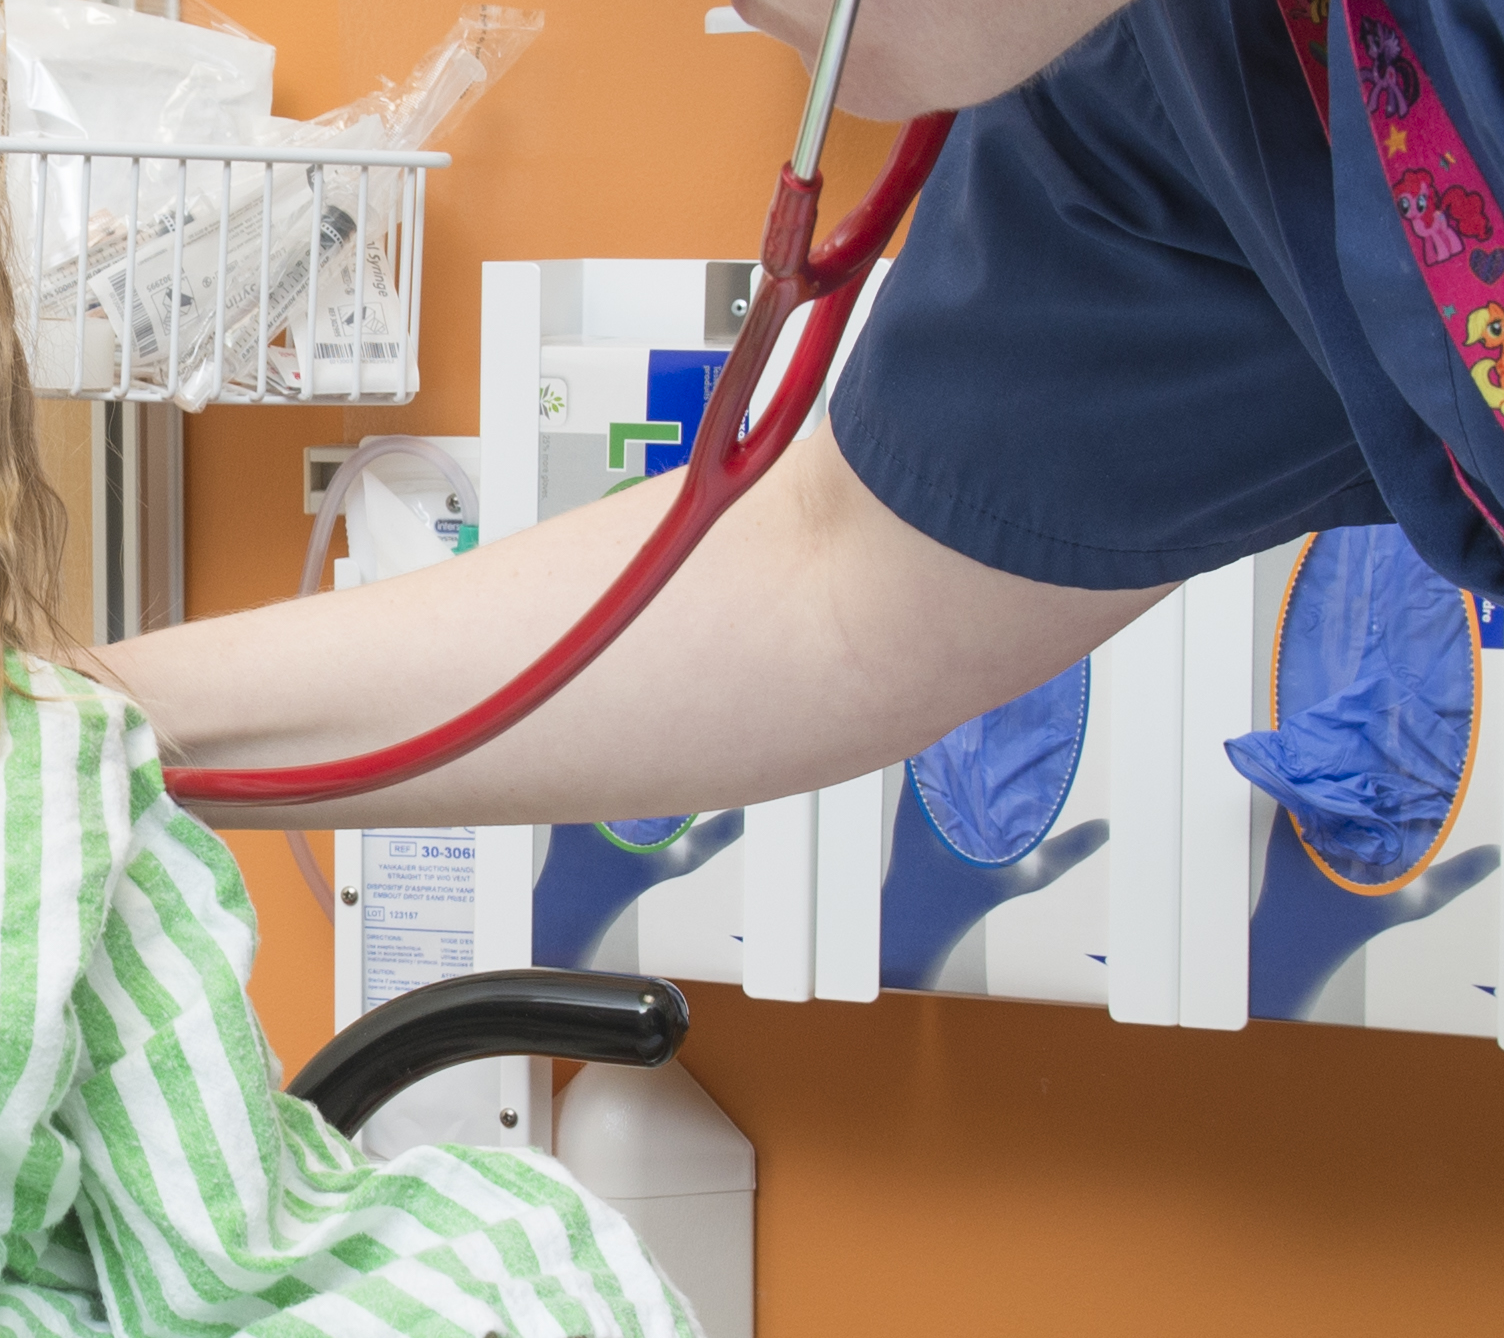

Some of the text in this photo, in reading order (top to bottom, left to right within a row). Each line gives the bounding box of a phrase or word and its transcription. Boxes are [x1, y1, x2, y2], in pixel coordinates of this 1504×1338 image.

[367, 252, 388, 298] Syringe
[607, 421, 681, 470] L
[394, 844, 411, 853] REF
[405, 884, 452, 893] D'ASPIRATION
